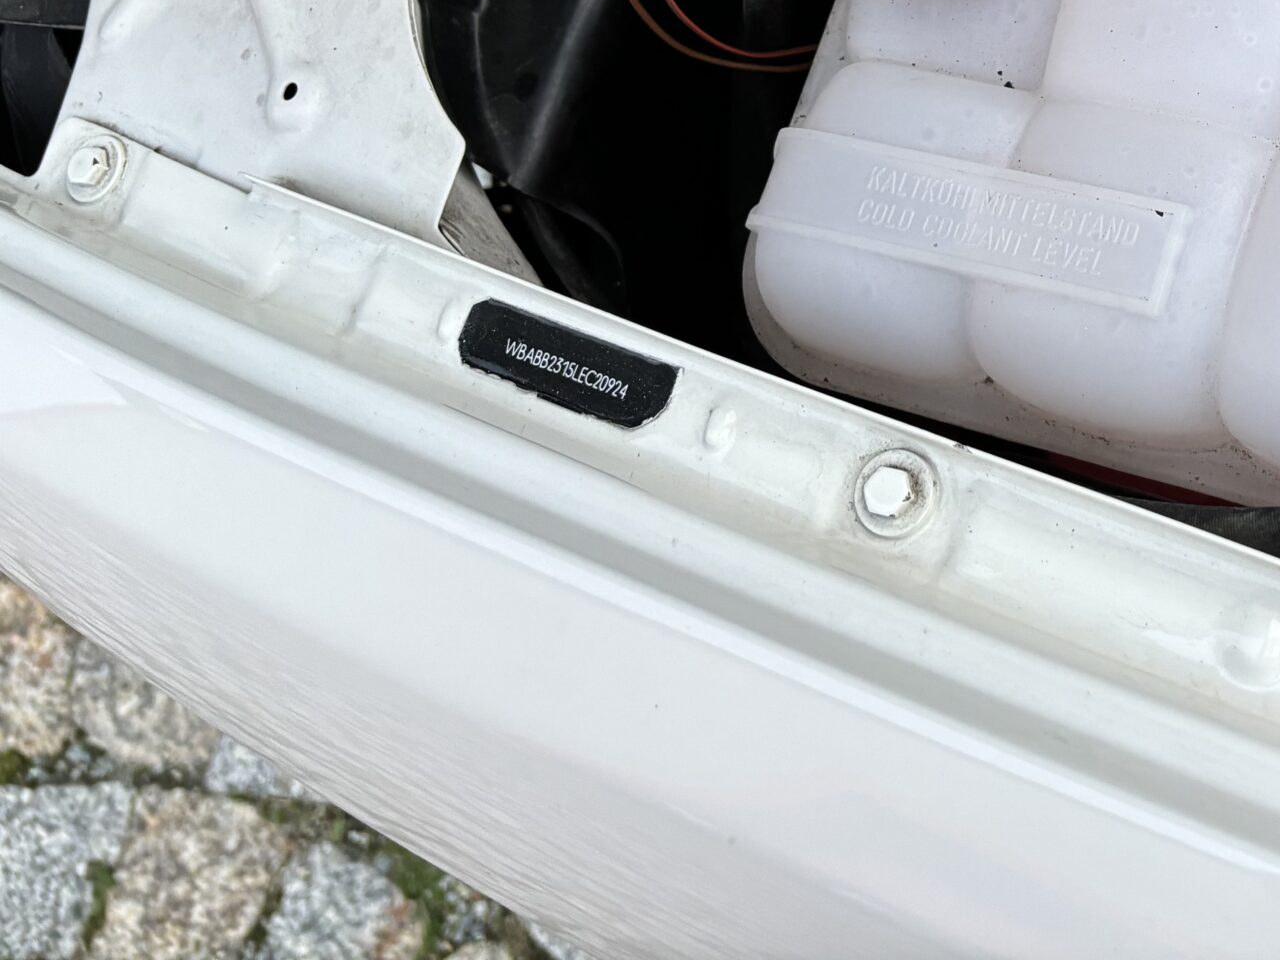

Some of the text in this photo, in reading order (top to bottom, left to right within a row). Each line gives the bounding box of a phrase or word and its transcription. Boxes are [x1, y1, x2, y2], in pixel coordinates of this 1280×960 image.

[858, 199, 915, 232] COLD
[1031, 236, 1102, 275] LEVEL
[505, 337, 630, 400] WBABB2315LEC20924
